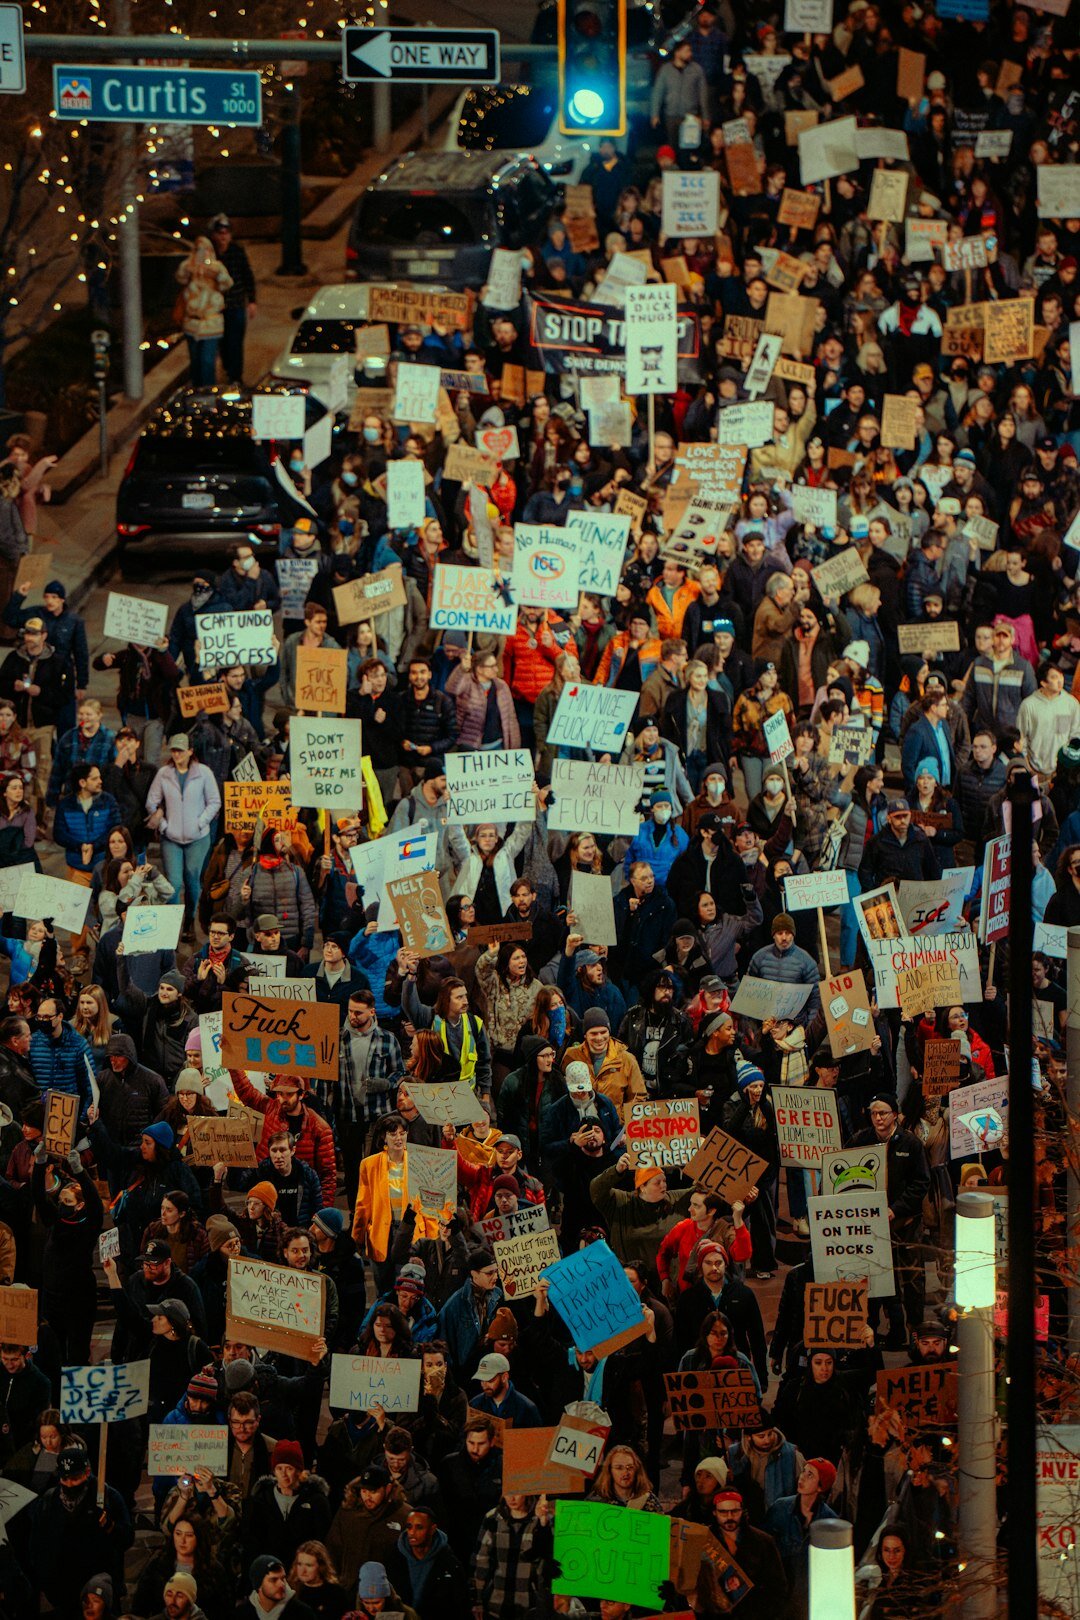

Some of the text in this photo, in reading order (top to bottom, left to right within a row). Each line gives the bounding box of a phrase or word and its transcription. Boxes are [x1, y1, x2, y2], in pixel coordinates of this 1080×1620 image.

[391, 46, 481, 66] ONE WAY
[102, 78, 207, 114] Curtis
[231, 82, 246, 98] St
[222, 99, 256, 114] 1000
[544, 313, 602, 343] STOP
[563, 355, 593, 371] SAVE
[256, 402, 299, 417] FUCK
[263, 419, 291, 436] ICE
[687, 447, 716, 458] LOVE
[515, 530, 577, 553] No Human
[533, 556, 561, 572] ICE
[440, 567, 489, 592] LIAR
[438, 591, 496, 611] LOSER
[237, 613, 273, 628] UNDO
[434, 609, 512, 631] CON-MAN
[203, 633, 237, 650] DUE
[203, 648, 276, 669] PROCESS
[307, 667, 335, 686] FUCK
[181, 685, 223, 699] NO HUMAN
[300, 685, 339, 705] FACISM
[184, 701, 194, 711] IS
[592, 693, 626, 718] NICE
[306, 732, 345, 746] DON'T
[553, 714, 614, 746] FUCK ICE
[299, 748, 345, 766] SHOOT!
[770, 738, 794, 763] MIGRA
[234, 760, 256, 782] FUCK
[307, 766, 357, 779] TAZE ME
[457, 753, 525, 774] THINK
[554, 760, 645, 789] ICE AGENTS
[230, 784, 274, 797] IF THIS IS
[314, 782, 344, 796] BRO
[583, 784, 605, 798] ARE
[227, 797, 268, 810] THE LAW
[447, 790, 536, 818] ABOLISH ICE
[559, 797, 626, 828] FUGLY
[226, 811, 243, 819] THEN
[226, 819, 257, 830] PRESIDEN
[391, 876, 426, 898] MELT
[787, 877, 812, 888] STAND
[792, 887, 846, 905] PROTEST
[993, 892, 1006, 915] US
[913, 910, 947, 924] ICE
[913, 932, 977, 952] NOT ABOUT
[891, 949, 959, 970] CRIMINALS
[829, 976, 853, 995] NO
[877, 970, 888, 987] IF
[250, 984, 314, 1001] HISTORY
[229, 996, 311, 1042] Fuck
[831, 1004, 845, 1016] Ice
[854, 1012, 867, 1022] Ice
[927, 1042, 960, 1054] PRISON
[930, 1068, 948, 1077] IS A
[409, 1085, 469, 1102] FUCK
[778, 1093, 803, 1110] LAND
[812, 1095, 830, 1112] THE
[973, 1089, 1009, 1107] FASCISM
[50, 1095, 73, 1118] FU
[416, 1103, 458, 1122] ICE
[631, 1100, 694, 1121] get your
[47, 1115, 70, 1136] CK
[626, 1116, 699, 1139] GESTAPO
[776, 1108, 834, 1129] GREED
[781, 1127, 808, 1144] HOME
[815, 1129, 835, 1145] THE
[46, 1137, 71, 1156] ICE
[703, 1130, 761, 1183] FUCK
[698, 1160, 737, 1198] ICE
[482, 1207, 545, 1234] NO TRUMP
[815, 1207, 881, 1221] FASCISM
[485, 1222, 536, 1242] NO KKK
[822, 1225, 872, 1238] ON THE
[520, 1239, 534, 1251] LET
[535, 1235, 555, 1248] THEM
[825, 1244, 874, 1257] ROCKS
[508, 1248, 559, 1268] NUMB YOUR
[232, 1261, 320, 1293] IMMIGRANTS
[547, 1252, 603, 1296] FUCK
[257, 1284, 289, 1299] MAKE
[557, 1265, 620, 1316] TRUMP!
[809, 1287, 866, 1313] FUCK
[240, 1290, 297, 1313] AMERICA
[249, 1305, 299, 1327] GREAT!
[568, 1291, 620, 1338] FUCK
[351, 1358, 402, 1376] CHINGA
[61, 1364, 132, 1390] ICE
[369, 1376, 386, 1389] LA
[666, 1370, 755, 1392] NO ICE
[349, 1390, 410, 1409] MIGRA!
[670, 1393, 705, 1413] NO
[673, 1411, 761, 1430] NO KINGS
[154, 1428, 189, 1441] WHEN
[555, 1435, 598, 1464] CAVA
[1036, 1451, 1070, 1460] elcome
[557, 1504, 652, 1545] ICE
[671, 1521, 692, 1542] CE
[560, 1546, 664, 1594] OUT!
